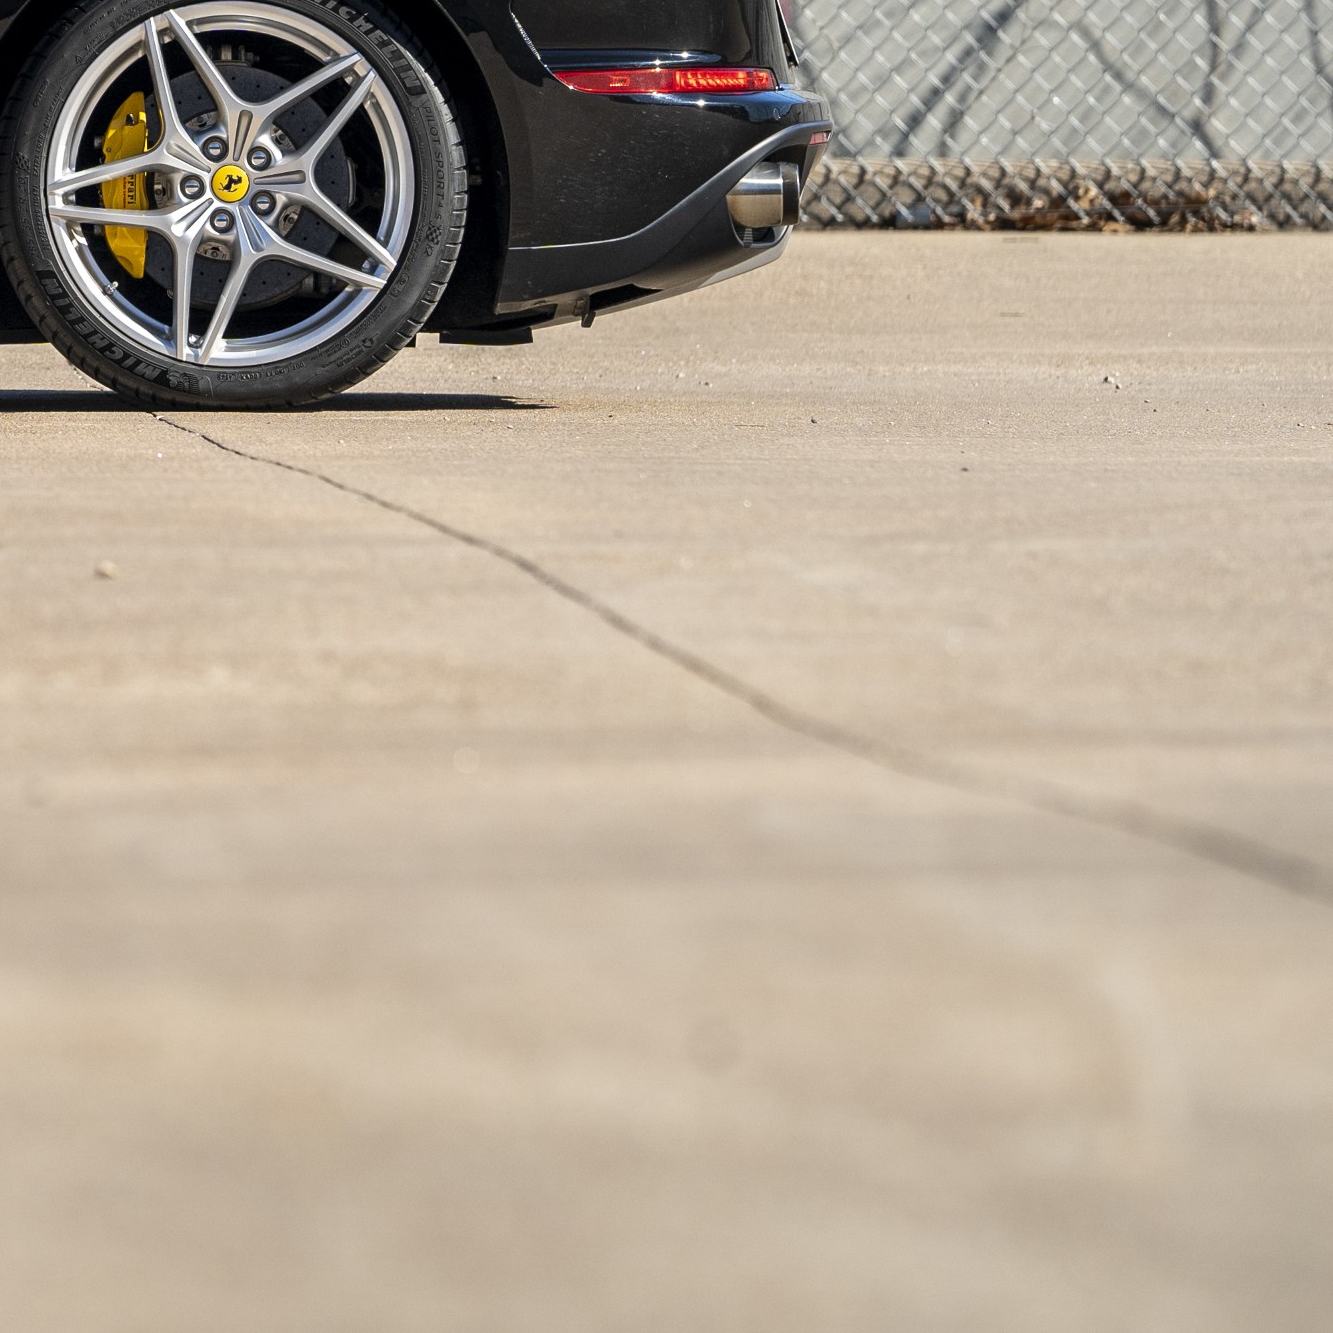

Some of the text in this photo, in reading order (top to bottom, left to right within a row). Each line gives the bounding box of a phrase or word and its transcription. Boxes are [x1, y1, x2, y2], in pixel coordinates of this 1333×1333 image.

[422, 106, 441, 145] PILOT
[434, 152, 445, 200] SPORT
[42, 278, 163, 381] MICHELIN
[336, 348, 364, 368] MICHELIN
